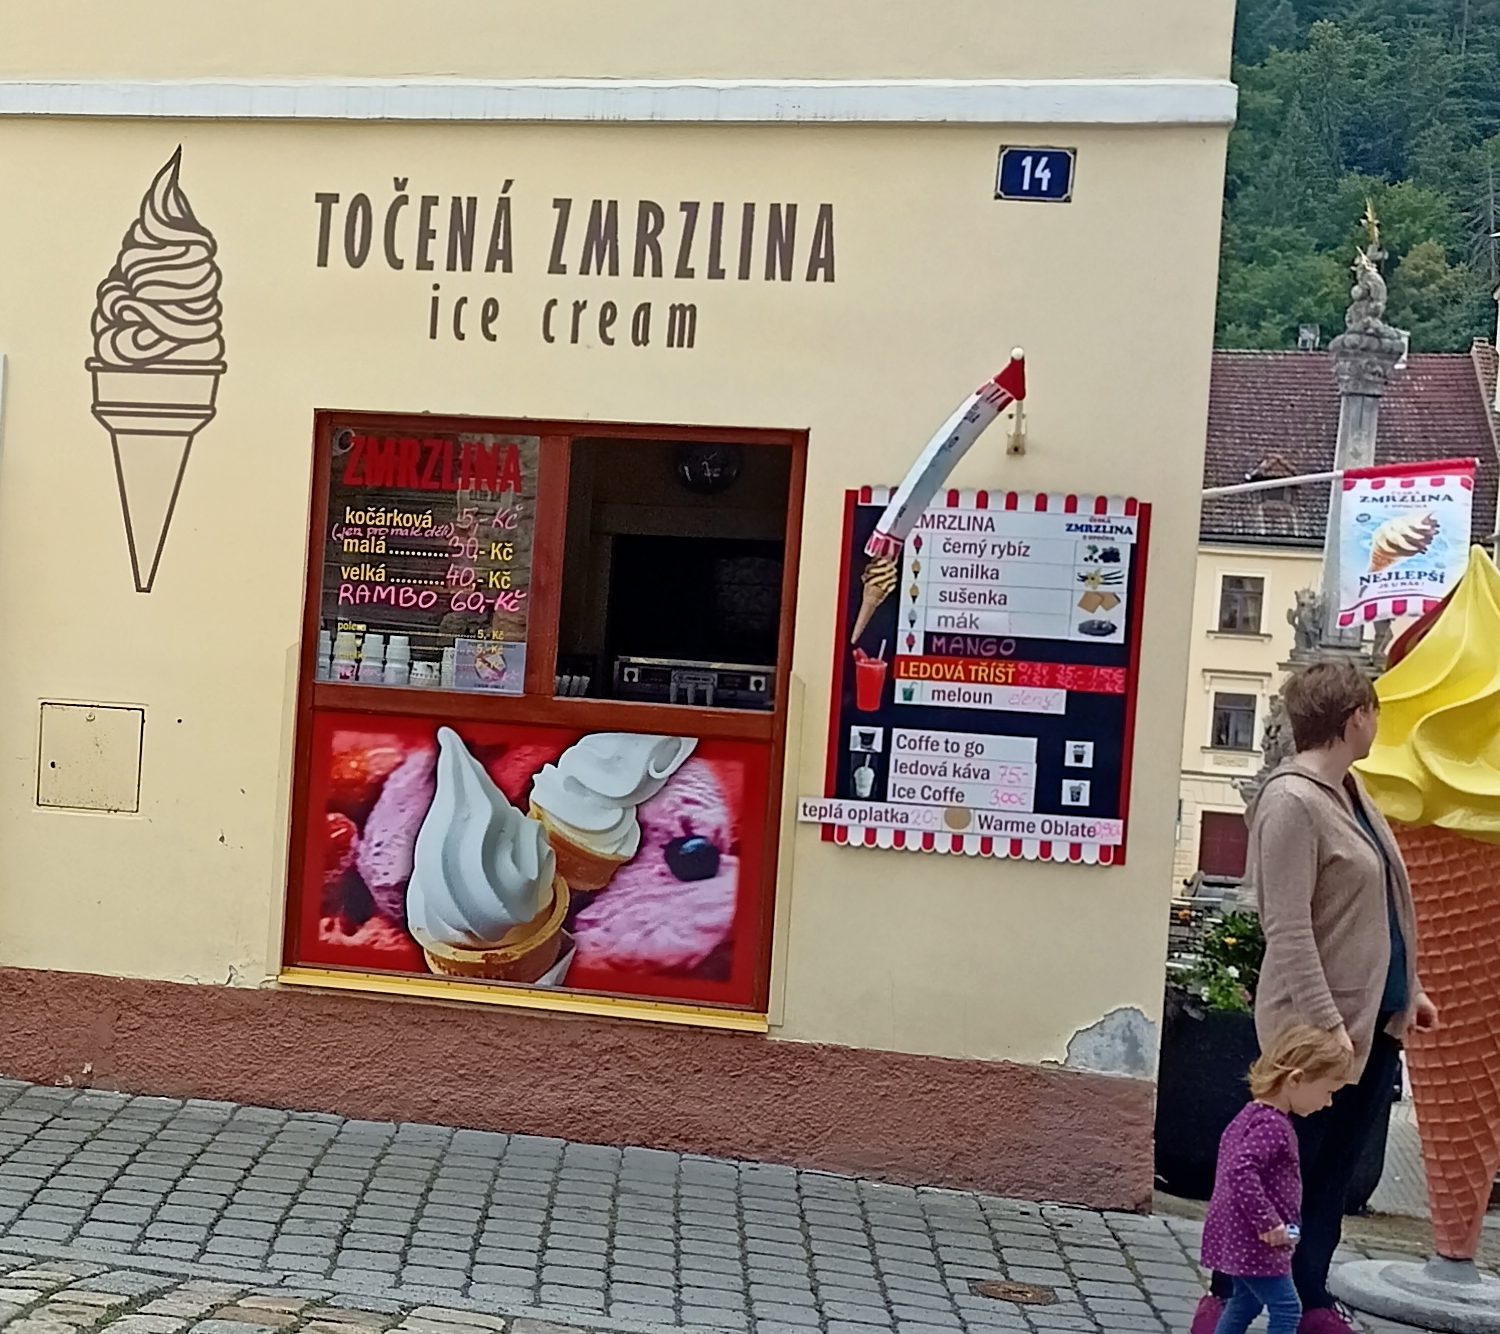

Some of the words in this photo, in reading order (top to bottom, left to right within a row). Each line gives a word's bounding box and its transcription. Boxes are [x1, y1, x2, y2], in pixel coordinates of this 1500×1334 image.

[1022, 155, 1052, 193] 14
[315, 177, 514, 274] TOČENÁ
[548, 198, 836, 283] ZMRZLINA
[429, 283, 500, 343] ice
[543, 294, 698, 350] cream
[342, 436, 522, 494] ZMRZLINA
[1360, 494, 1454, 504] ZMRZLINA
[345, 505, 433, 528] kočárková
[914, 514, 996, 534] MRZLINA
[1065, 522, 1134, 535] ZMRZLINA
[343, 535, 386, 554] malá
[490, 542, 514, 561] Kč
[942, 537, 988, 560] černý
[991, 539, 1031, 560] rybíz
[340, 563, 386, 582] velká
[488, 571, 512, 590] Kč
[940, 563, 1000, 581] vanilka
[1359, 570, 1445, 586] NEJLEPŠÍ
[337, 584, 438, 609] RAMBO
[938, 588, 1008, 607] sušenka
[936, 611, 980, 630] mák
[932, 635, 1017, 656] MANGO
[900, 660, 965, 681] LEDOVÁ
[968, 662, 1016, 683] TŘÍŠŤ
[931, 687, 993, 705] meloun
[896, 734, 940, 753] Coffe
[944, 737, 960, 754] to
[964, 742, 985, 758] go
[893, 758, 948, 778] ledová
[952, 761, 991, 781] káva
[891, 782, 916, 800] Ice
[920, 785, 965, 804] Coffe
[802, 802, 843, 822] teplá
[847, 804, 910, 825] oplatka
[977, 814, 1036, 835] Warme
[1040, 819, 1097, 839] Oblate
